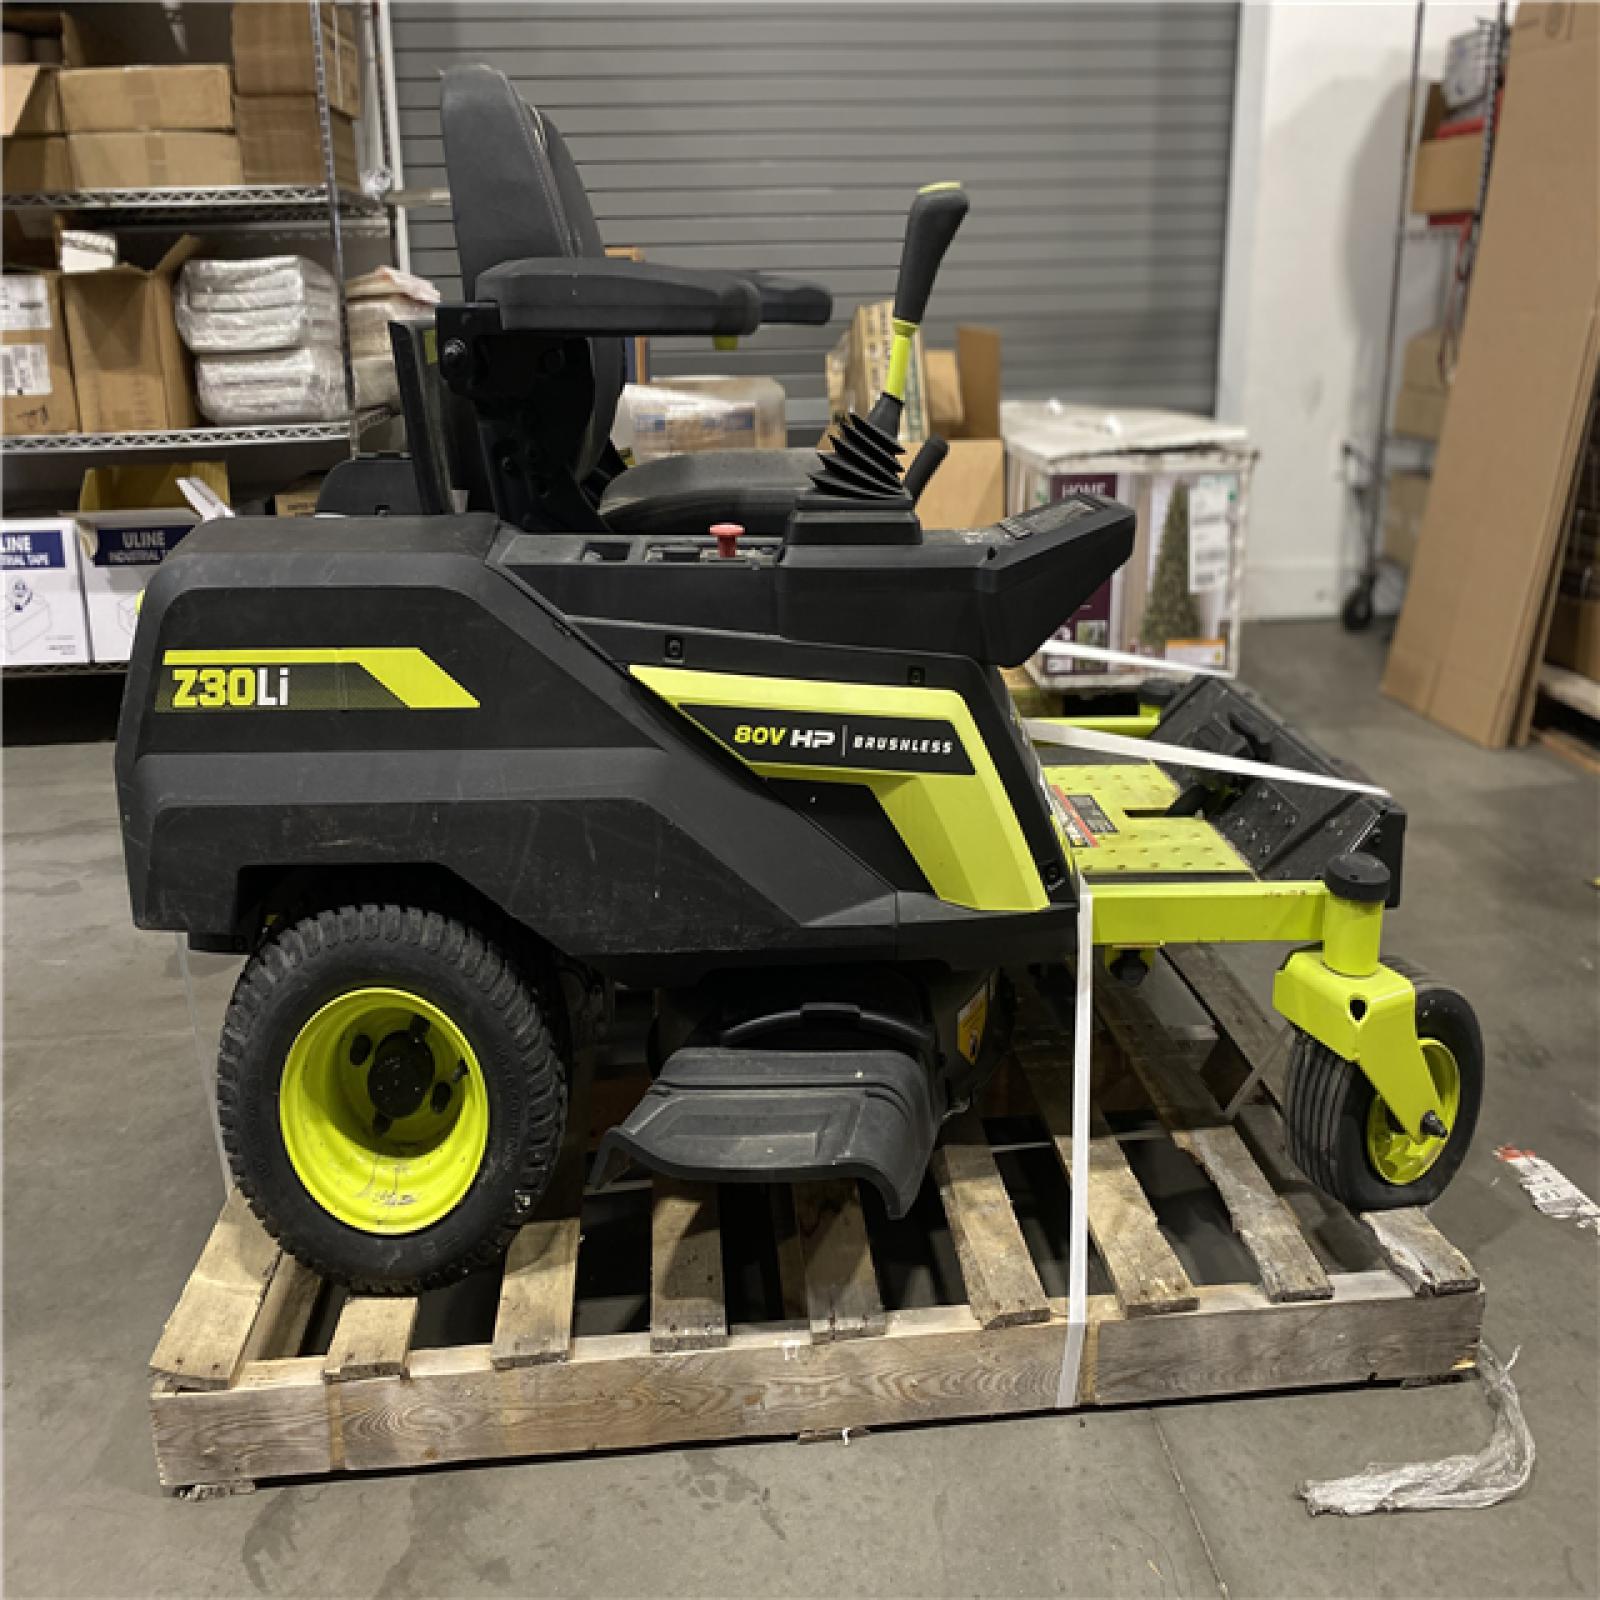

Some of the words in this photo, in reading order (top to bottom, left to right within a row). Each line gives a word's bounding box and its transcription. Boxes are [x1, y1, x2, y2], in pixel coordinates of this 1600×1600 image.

[122, 531, 166, 549] ULINE
[172, 667, 288, 708] Z30Li
[734, 724, 787, 746] 80V
[789, 729, 836, 748] HP
[853, 734, 953, 754] BRUSHLESS
